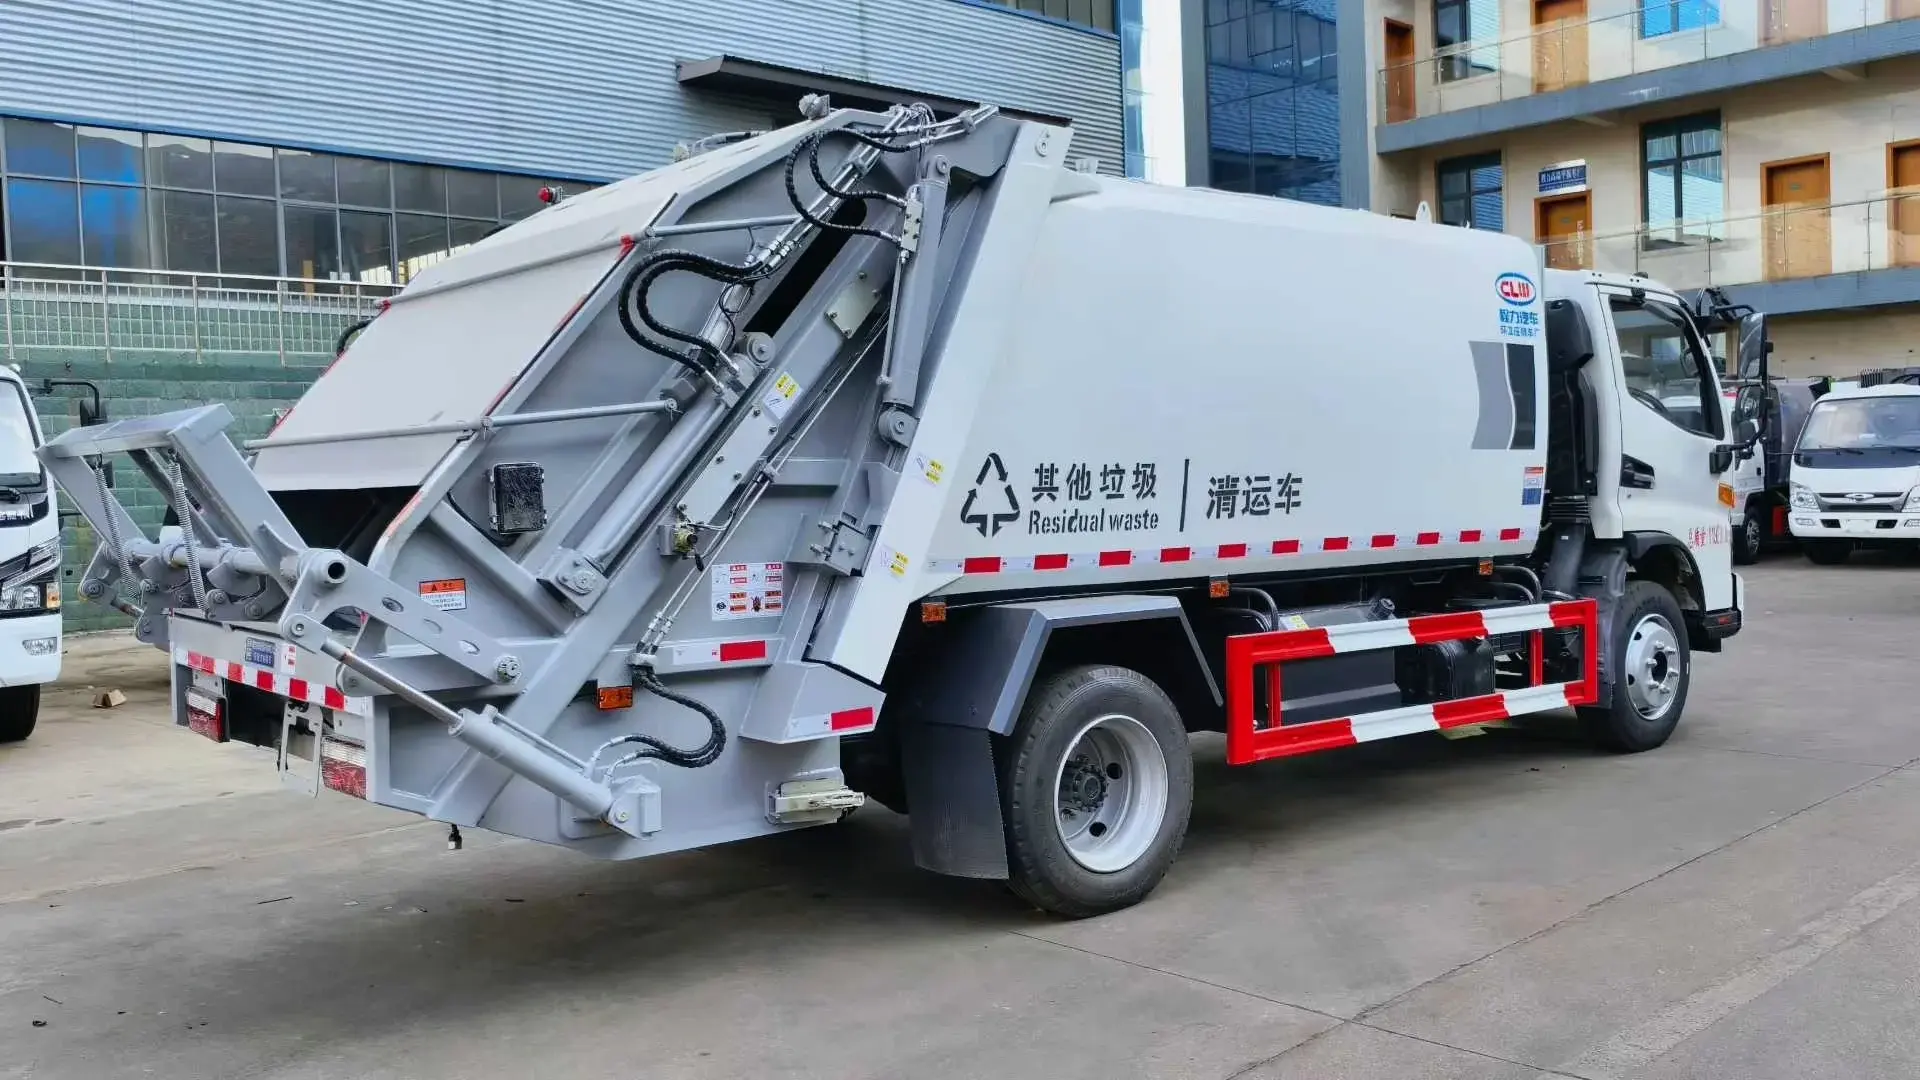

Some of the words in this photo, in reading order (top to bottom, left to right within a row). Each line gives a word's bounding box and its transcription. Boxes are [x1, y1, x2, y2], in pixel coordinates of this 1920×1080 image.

[1032, 462, 1157, 502] 其他垃圾
[1206, 472, 1303, 519] 清运车
[1029, 508, 1104, 534] Residual
[1110, 511, 1159, 532] waste
